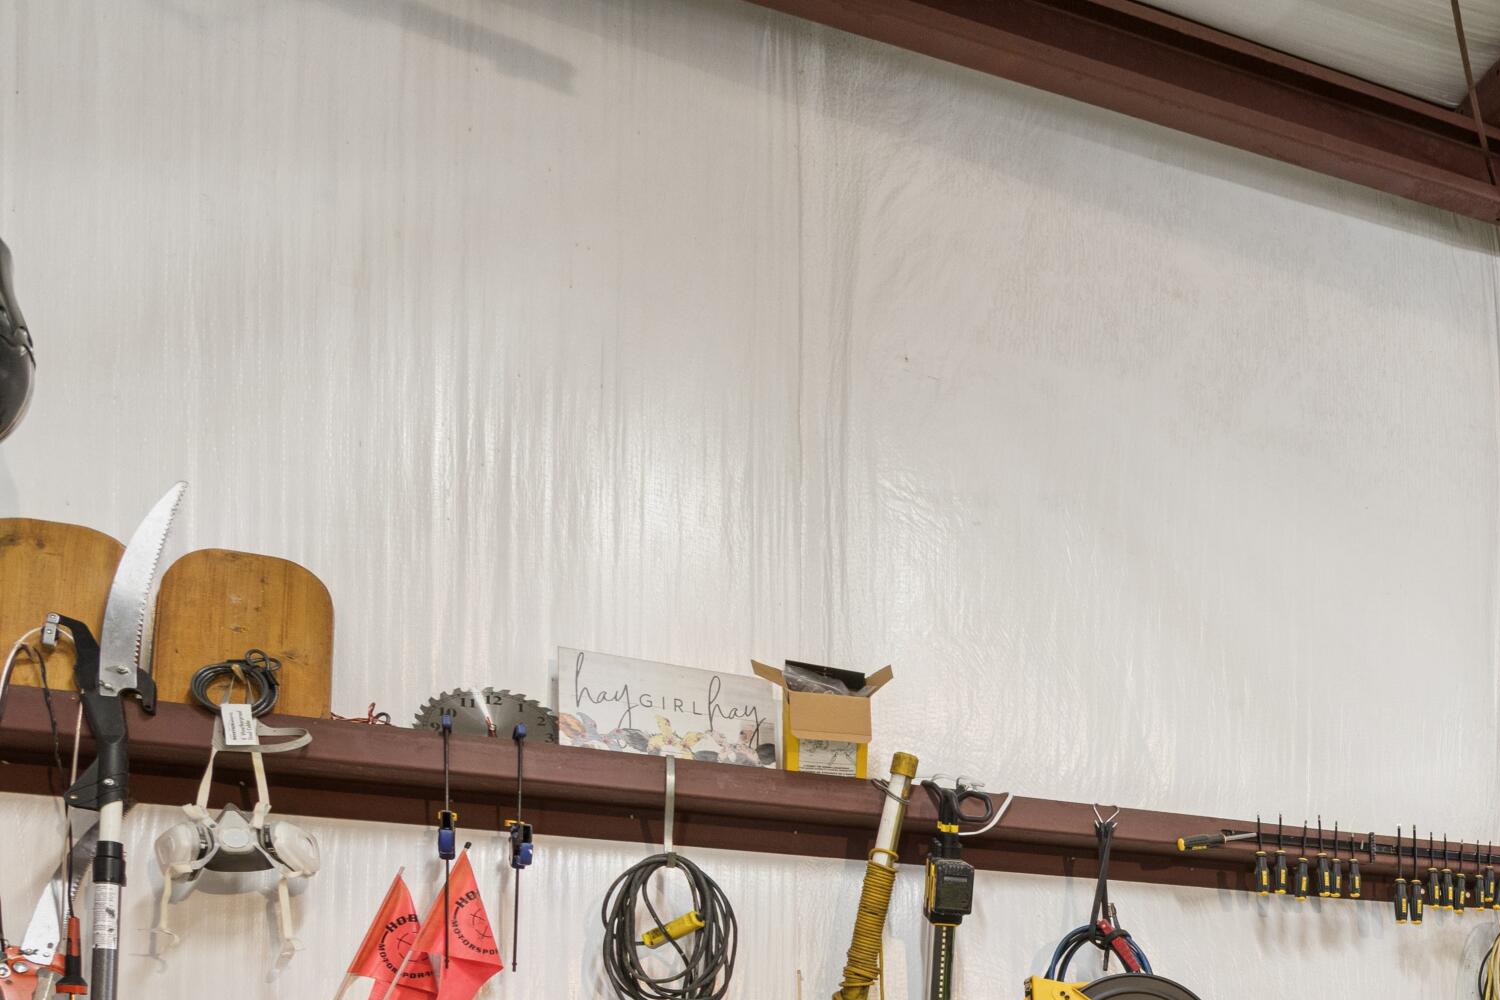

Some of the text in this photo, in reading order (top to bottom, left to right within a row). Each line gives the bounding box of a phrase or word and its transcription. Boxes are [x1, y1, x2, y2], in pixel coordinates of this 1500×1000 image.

[460, 697, 475, 708] 11
[485, 695, 502, 705] 12
[574, 652, 766, 749] hay GIRL hay
[518, 703, 524, 712] 1
[536, 716, 546, 726] 2
